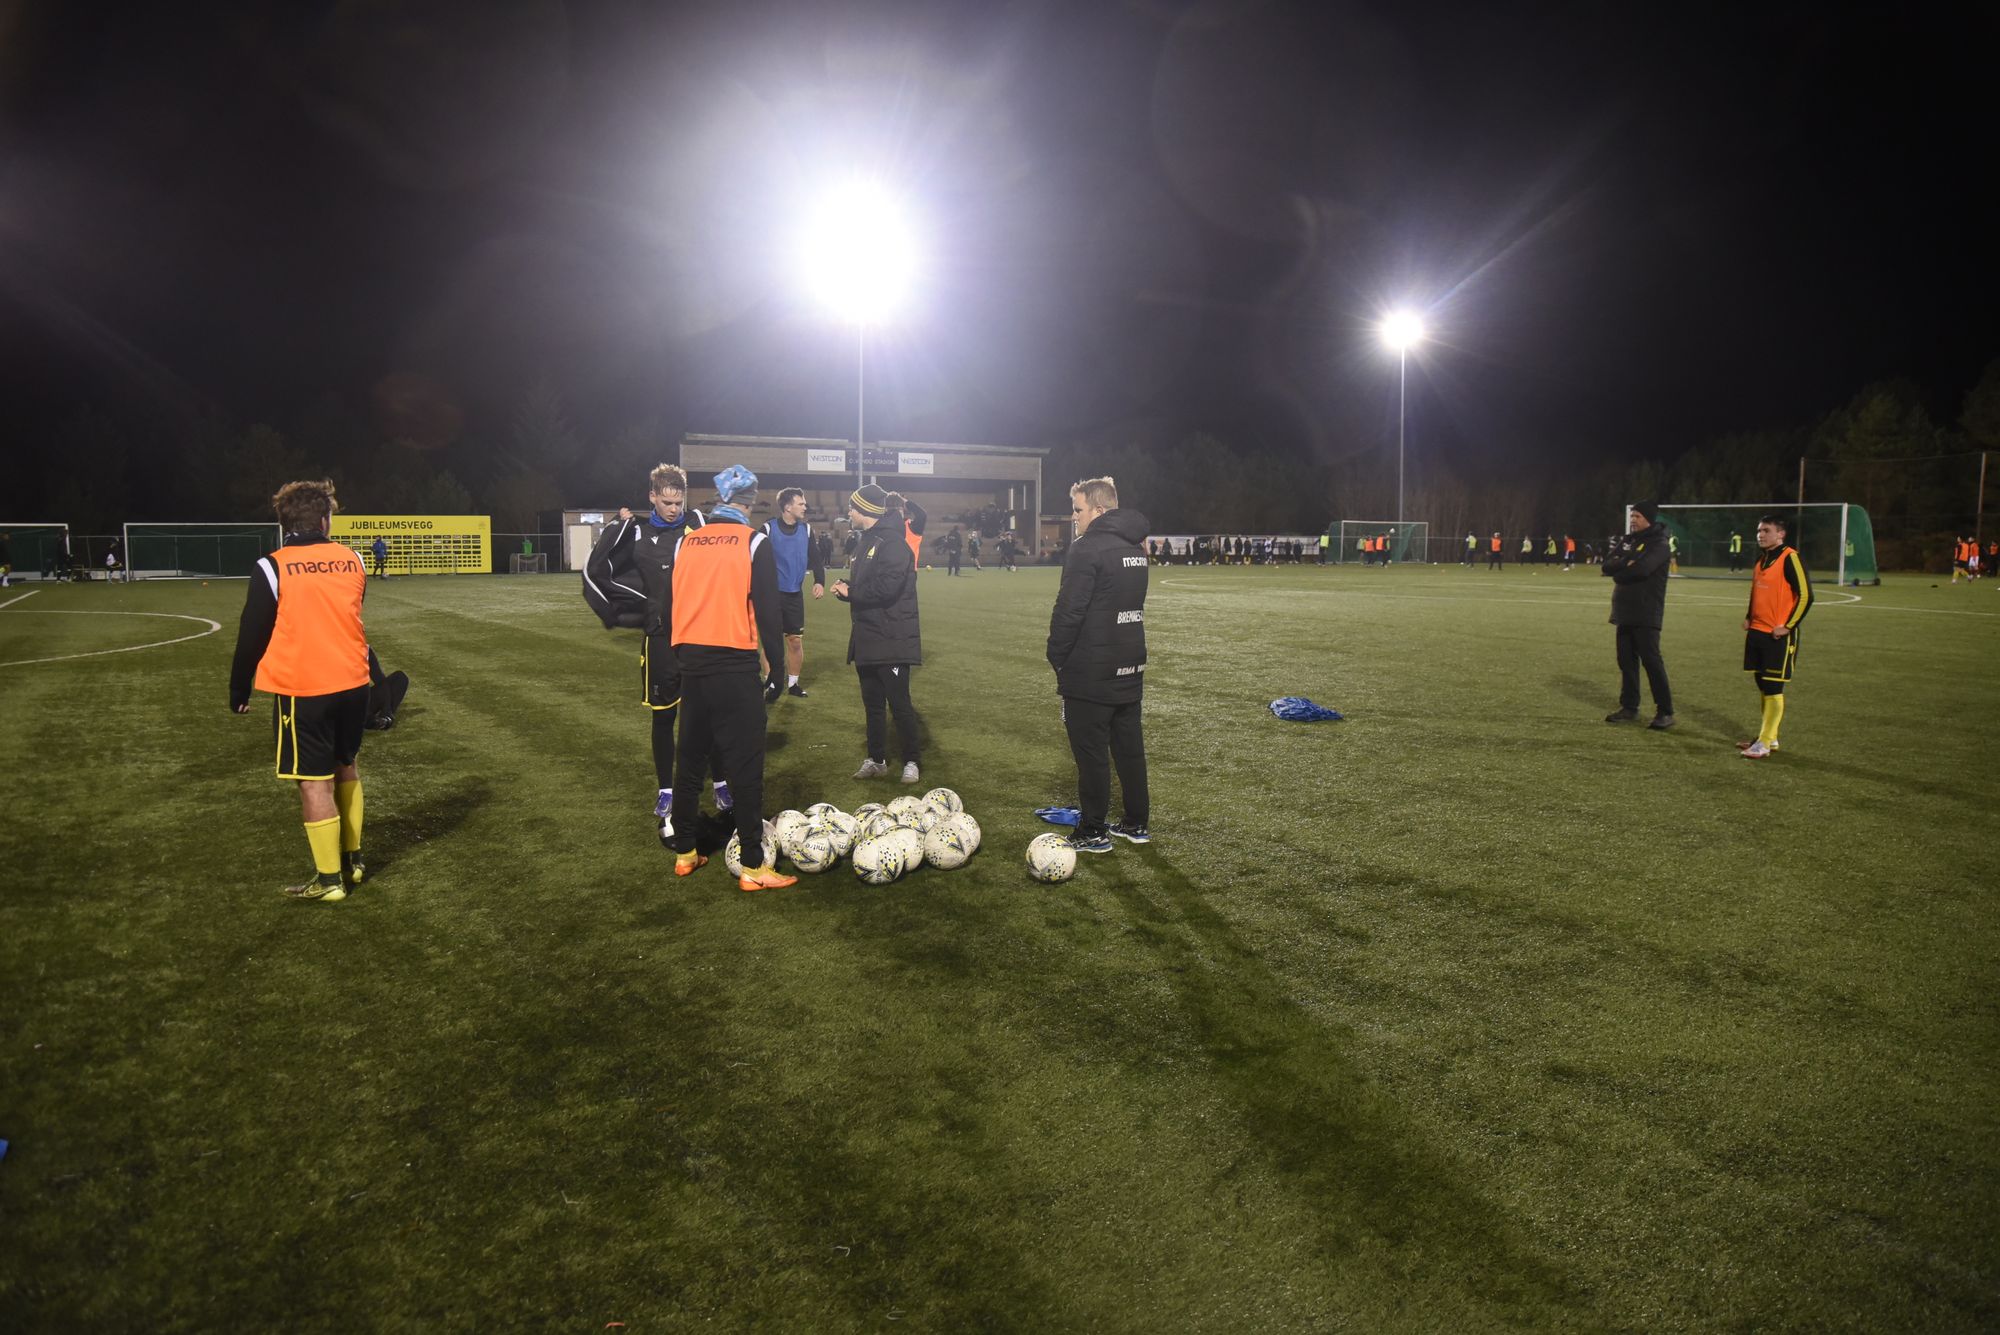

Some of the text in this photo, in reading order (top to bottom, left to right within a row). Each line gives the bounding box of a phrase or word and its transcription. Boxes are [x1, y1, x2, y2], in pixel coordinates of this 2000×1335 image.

[350, 521, 433, 530] JUBILEUMSVEGG
[687, 535, 739, 546] macron
[286, 560, 358, 576] macron
